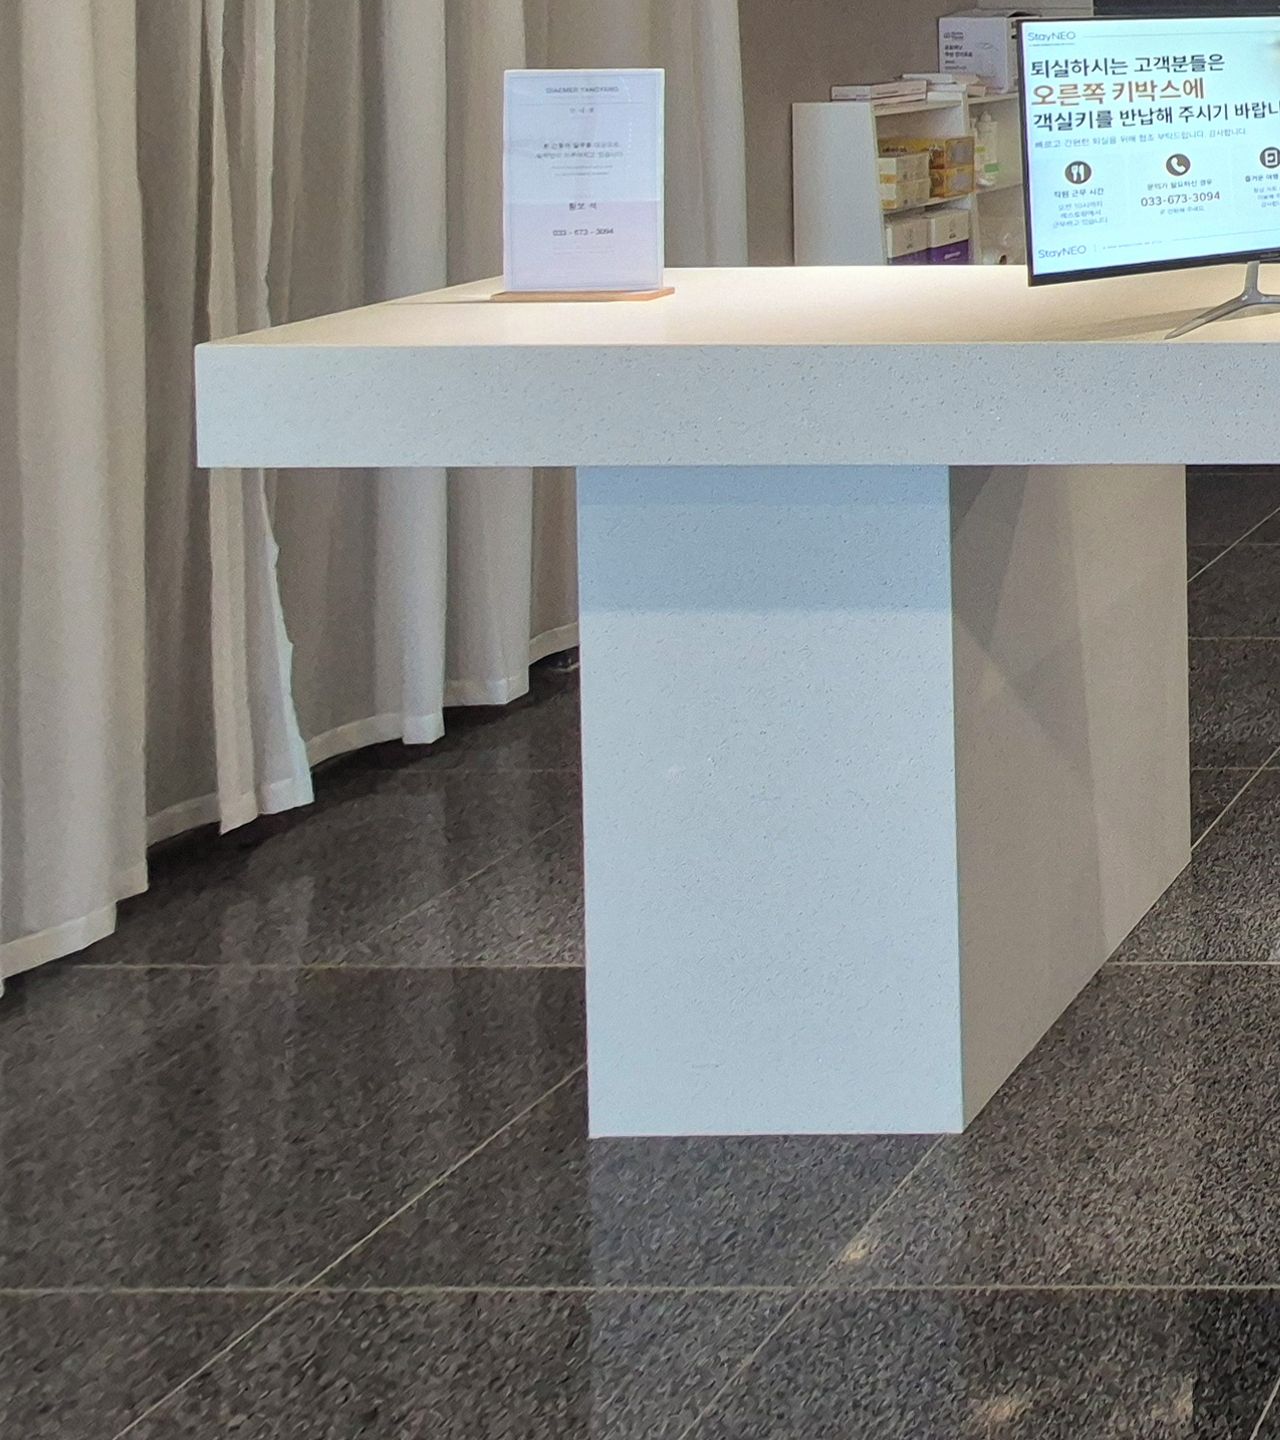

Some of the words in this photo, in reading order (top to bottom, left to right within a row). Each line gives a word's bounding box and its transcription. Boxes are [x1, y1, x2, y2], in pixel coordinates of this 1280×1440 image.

[1027, 31, 1076, 42] StayNEO
[1031, 58, 1129, 79] 퇴실하시는
[1133, 53, 1226, 74] 고객분들은
[1031, 82, 1106, 107] 오른쪽
[1112, 77, 1205, 102] 키박스에
[1033, 109, 1114, 132] 객실키를
[1119, 106, 1173, 127] 반납해
[1178, 103, 1228, 122] 주시기
[1140, 191, 1221, 207] 033-673-3094
[1038, 244, 1087, 259] StayNEO
